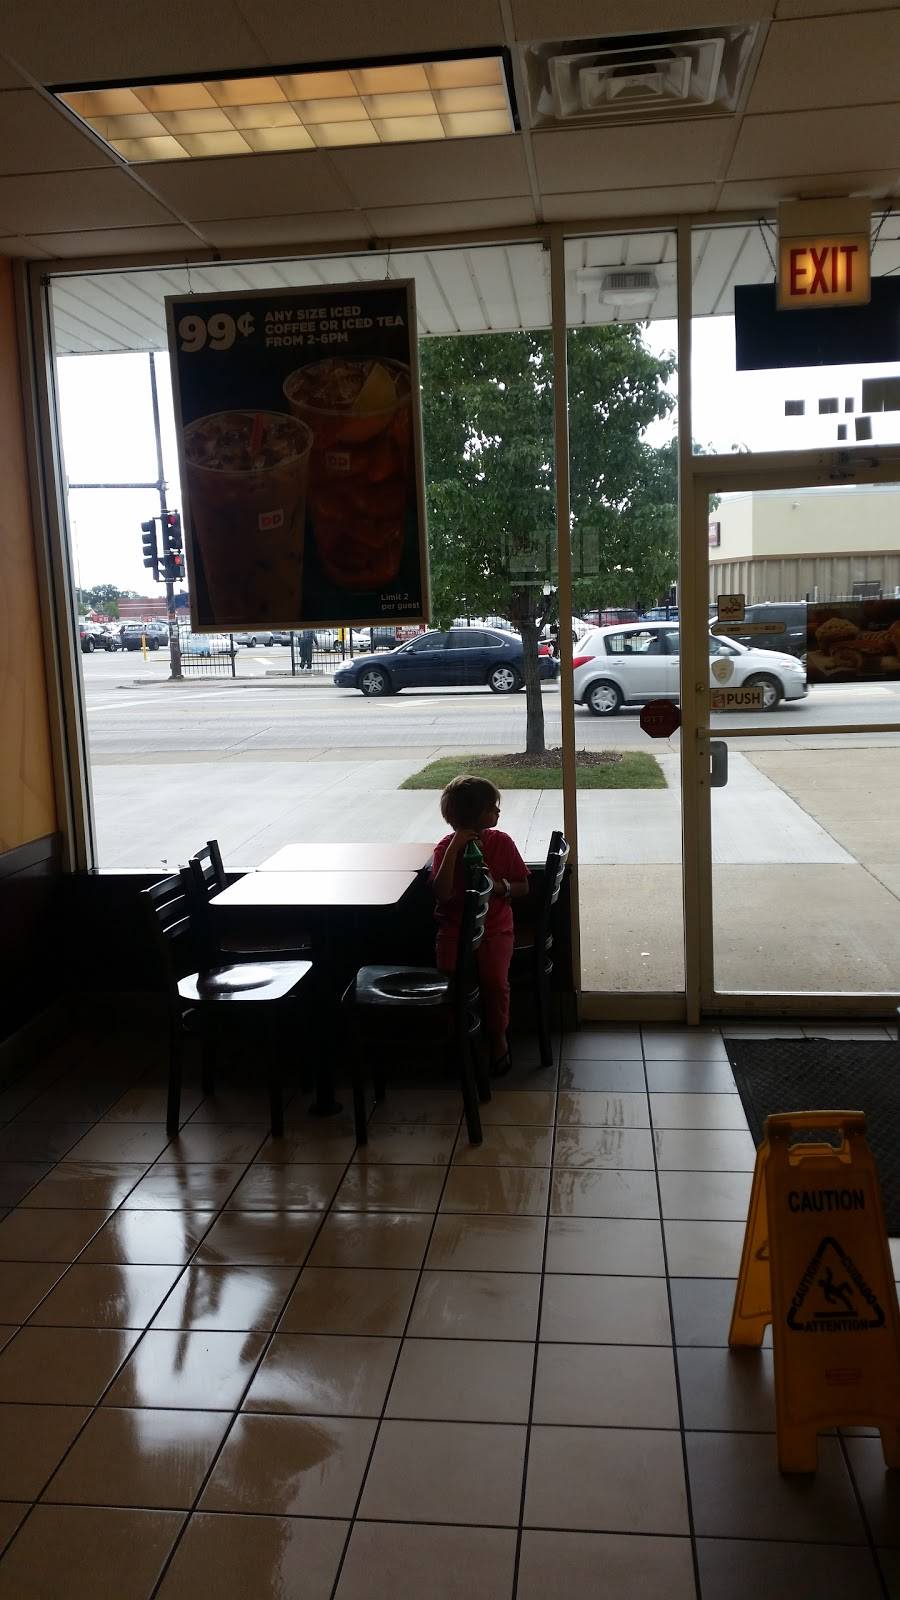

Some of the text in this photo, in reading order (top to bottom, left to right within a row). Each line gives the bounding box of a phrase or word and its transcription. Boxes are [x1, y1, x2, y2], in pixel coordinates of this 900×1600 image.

[790, 246, 858, 296] EXIT
[264, 305, 361, 322] ANY SIZE ICED
[178, 311, 256, 353] 99¢
[265, 315, 404, 335] COFFEE OR ICED TEA
[265, 331, 349, 348] FROM 2-6PM
[261, 514, 281, 528] DD
[380, 592, 409, 601] Limit 2
[381, 601, 420, 611] per guest
[726, 691, 761, 705] PUSH
[787, 1189, 865, 1213] CAUTION
[792, 1256, 820, 1308] CAUTION
[804, 1319, 869, 1333] ATTENTION
